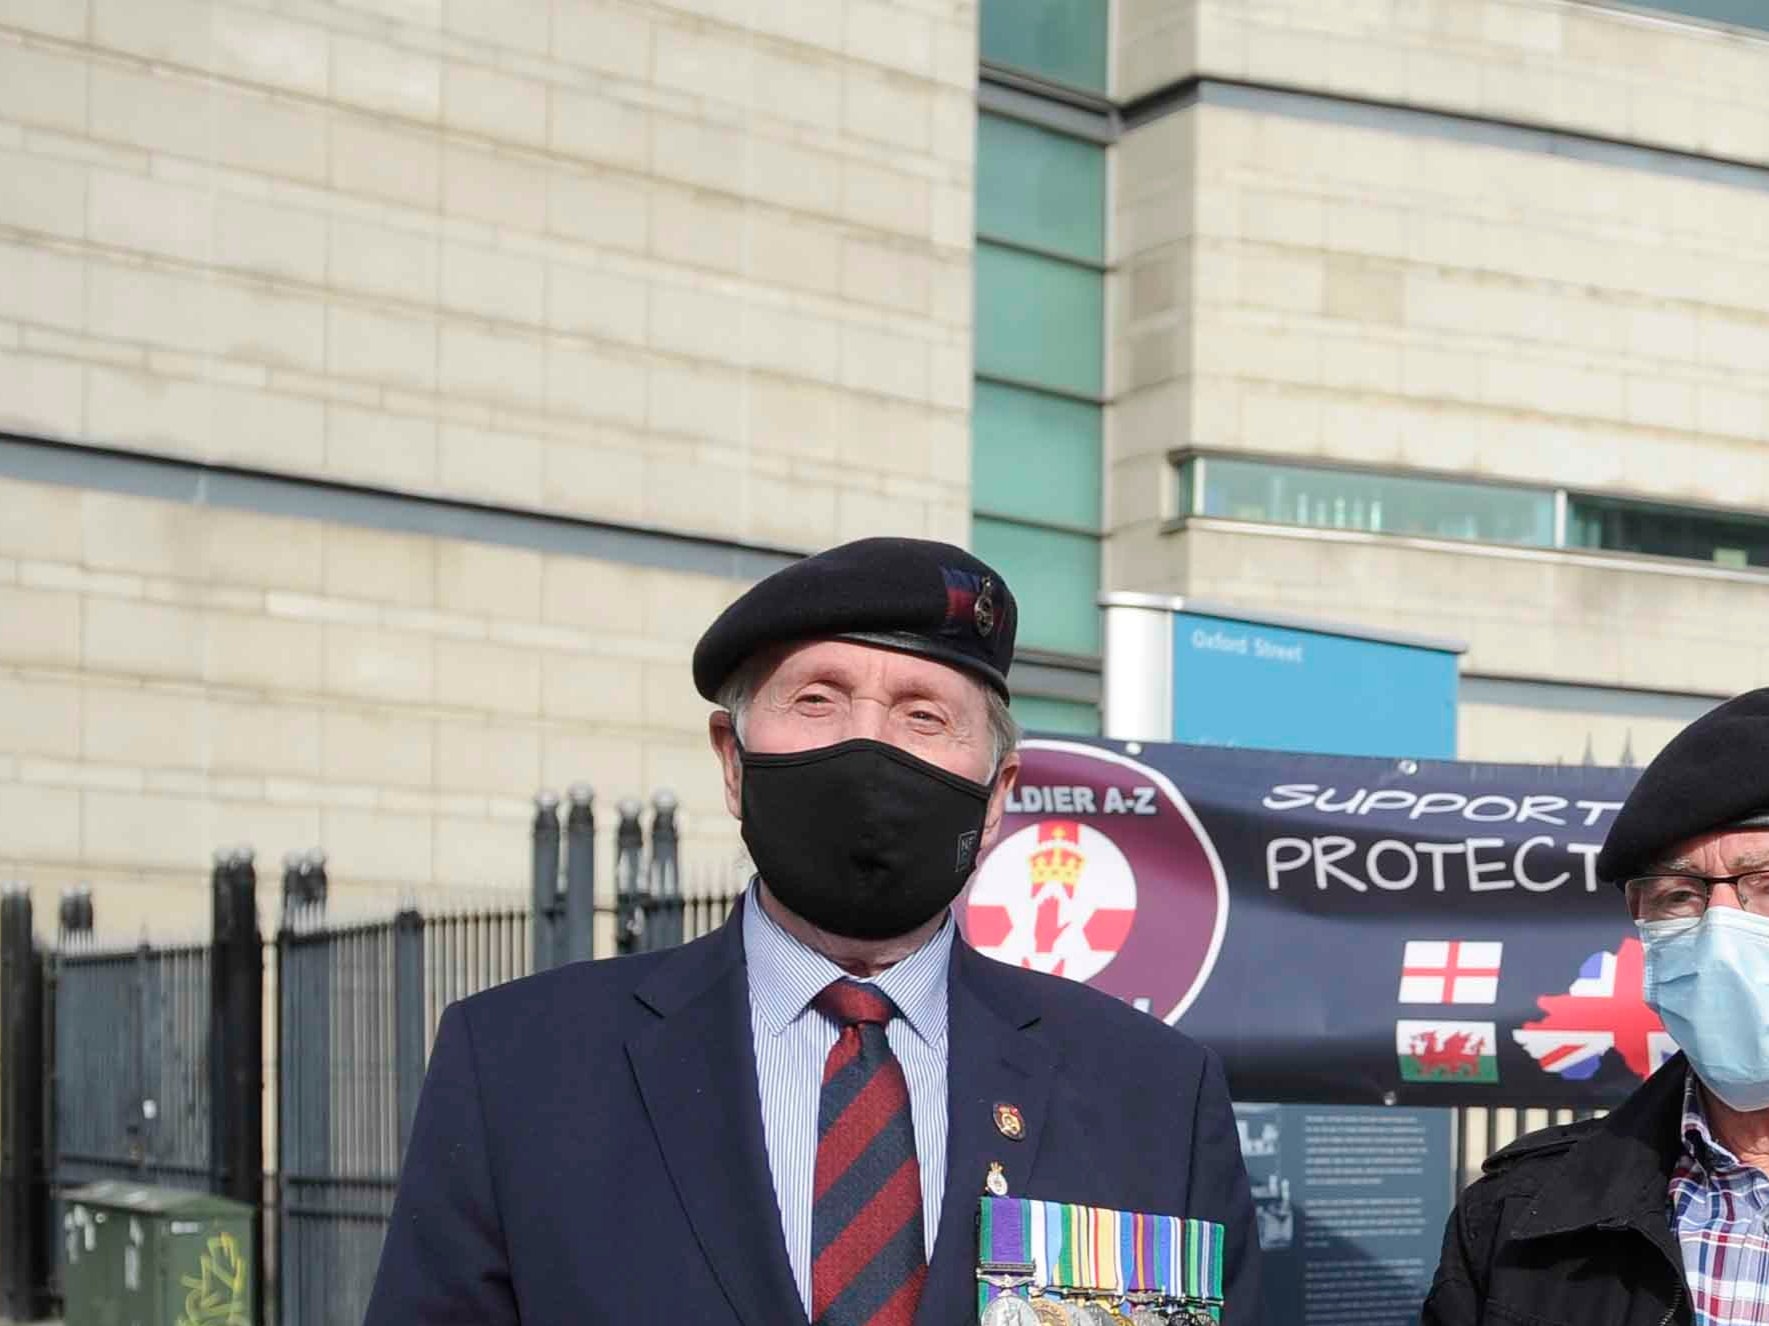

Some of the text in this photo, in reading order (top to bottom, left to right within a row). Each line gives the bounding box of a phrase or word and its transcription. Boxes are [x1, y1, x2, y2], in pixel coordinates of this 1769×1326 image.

[1191, 629, 1304, 663] Oxford Street
[1004, 785, 1158, 815] LDIER A-Z
[1262, 783, 1625, 826] SUPPORT
[1265, 835, 1603, 893] PROTECT
